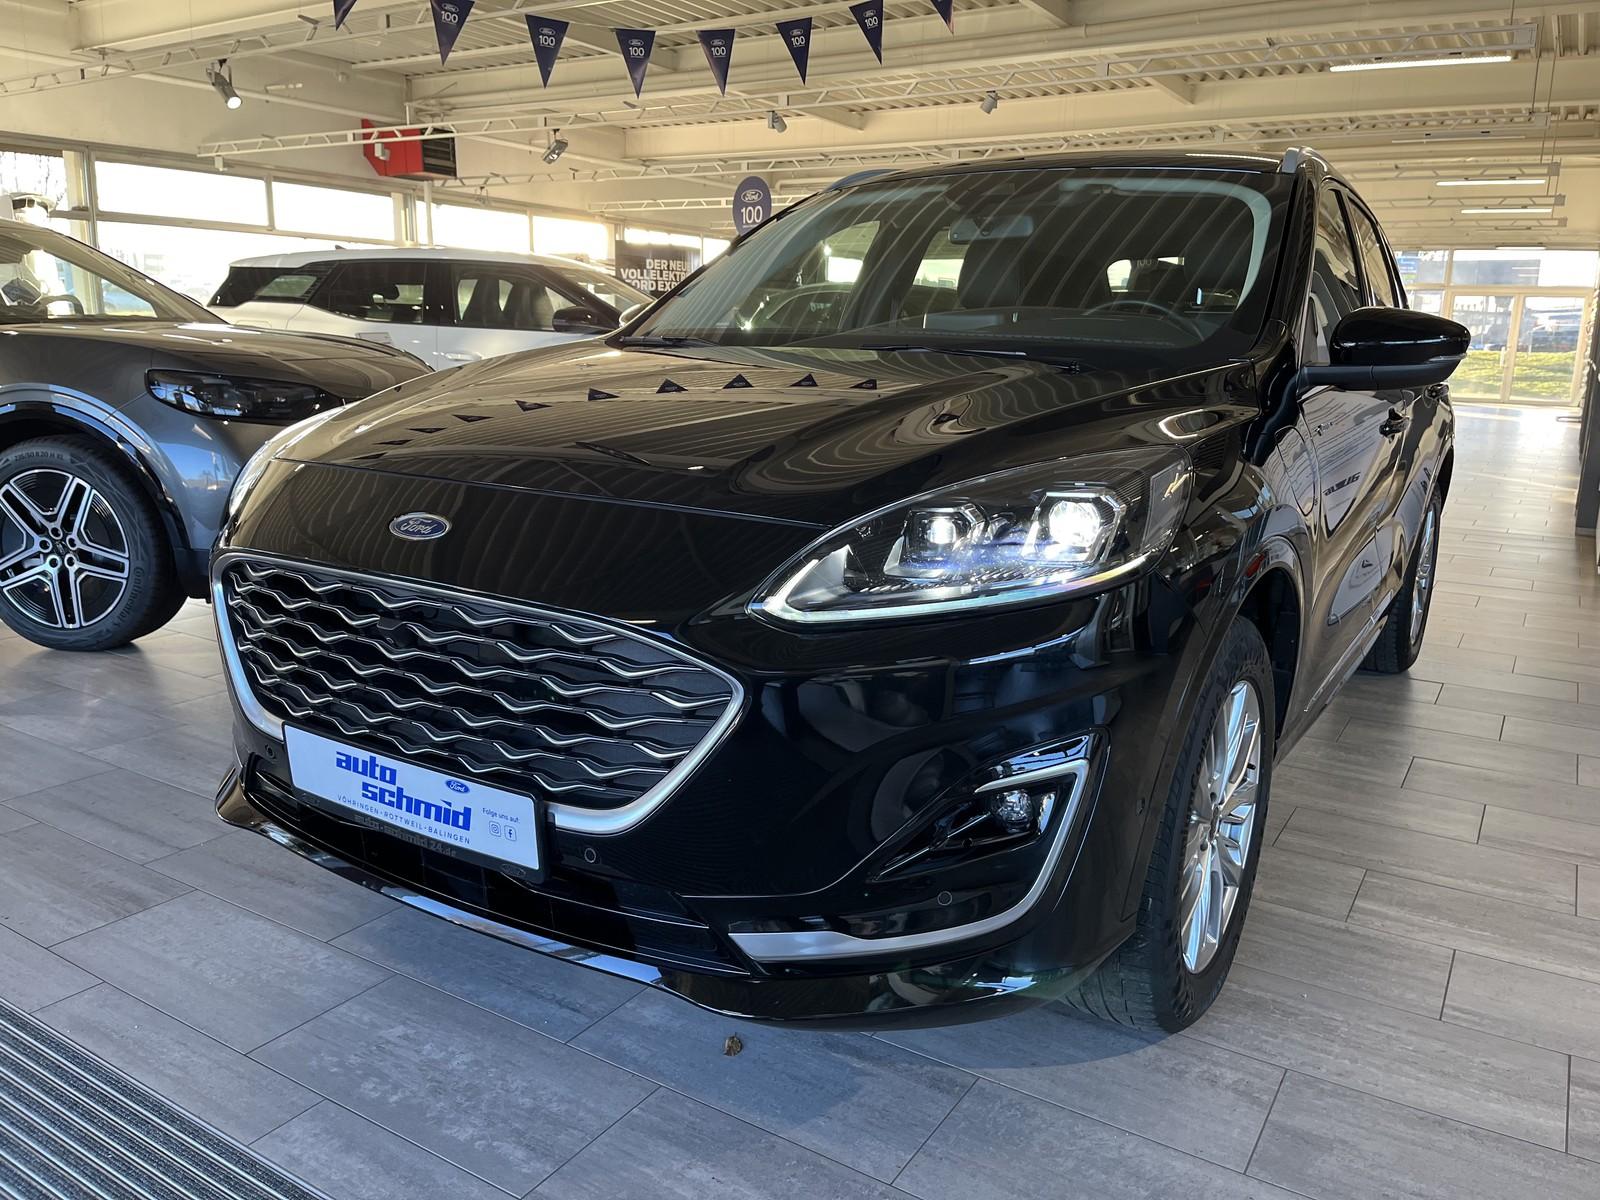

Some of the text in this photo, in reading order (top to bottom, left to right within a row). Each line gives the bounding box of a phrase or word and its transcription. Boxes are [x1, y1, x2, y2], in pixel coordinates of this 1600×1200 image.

[441, 11, 459, 23] 100
[864, 16, 879, 27] 100
[538, 35, 556, 47] 100
[791, 36, 806, 46] 100
[628, 47, 645, 57] 100
[711, 46, 726, 56] 100
[743, 190, 761, 202] Ford
[741, 206, 763, 224] 100
[646, 258, 669, 270] DER
[625, 279, 657, 291] ORD
[336, 751, 397, 786] auto
[362, 781, 472, 831] schmid
[337, 793, 379, 814] VÖHRINGEN
[384, 811, 424, 831] ROTTWEIL
[428, 826, 471, 845] BALINGEN
[482, 807, 498, 818] Folge
[498, 813, 509, 821] uns
